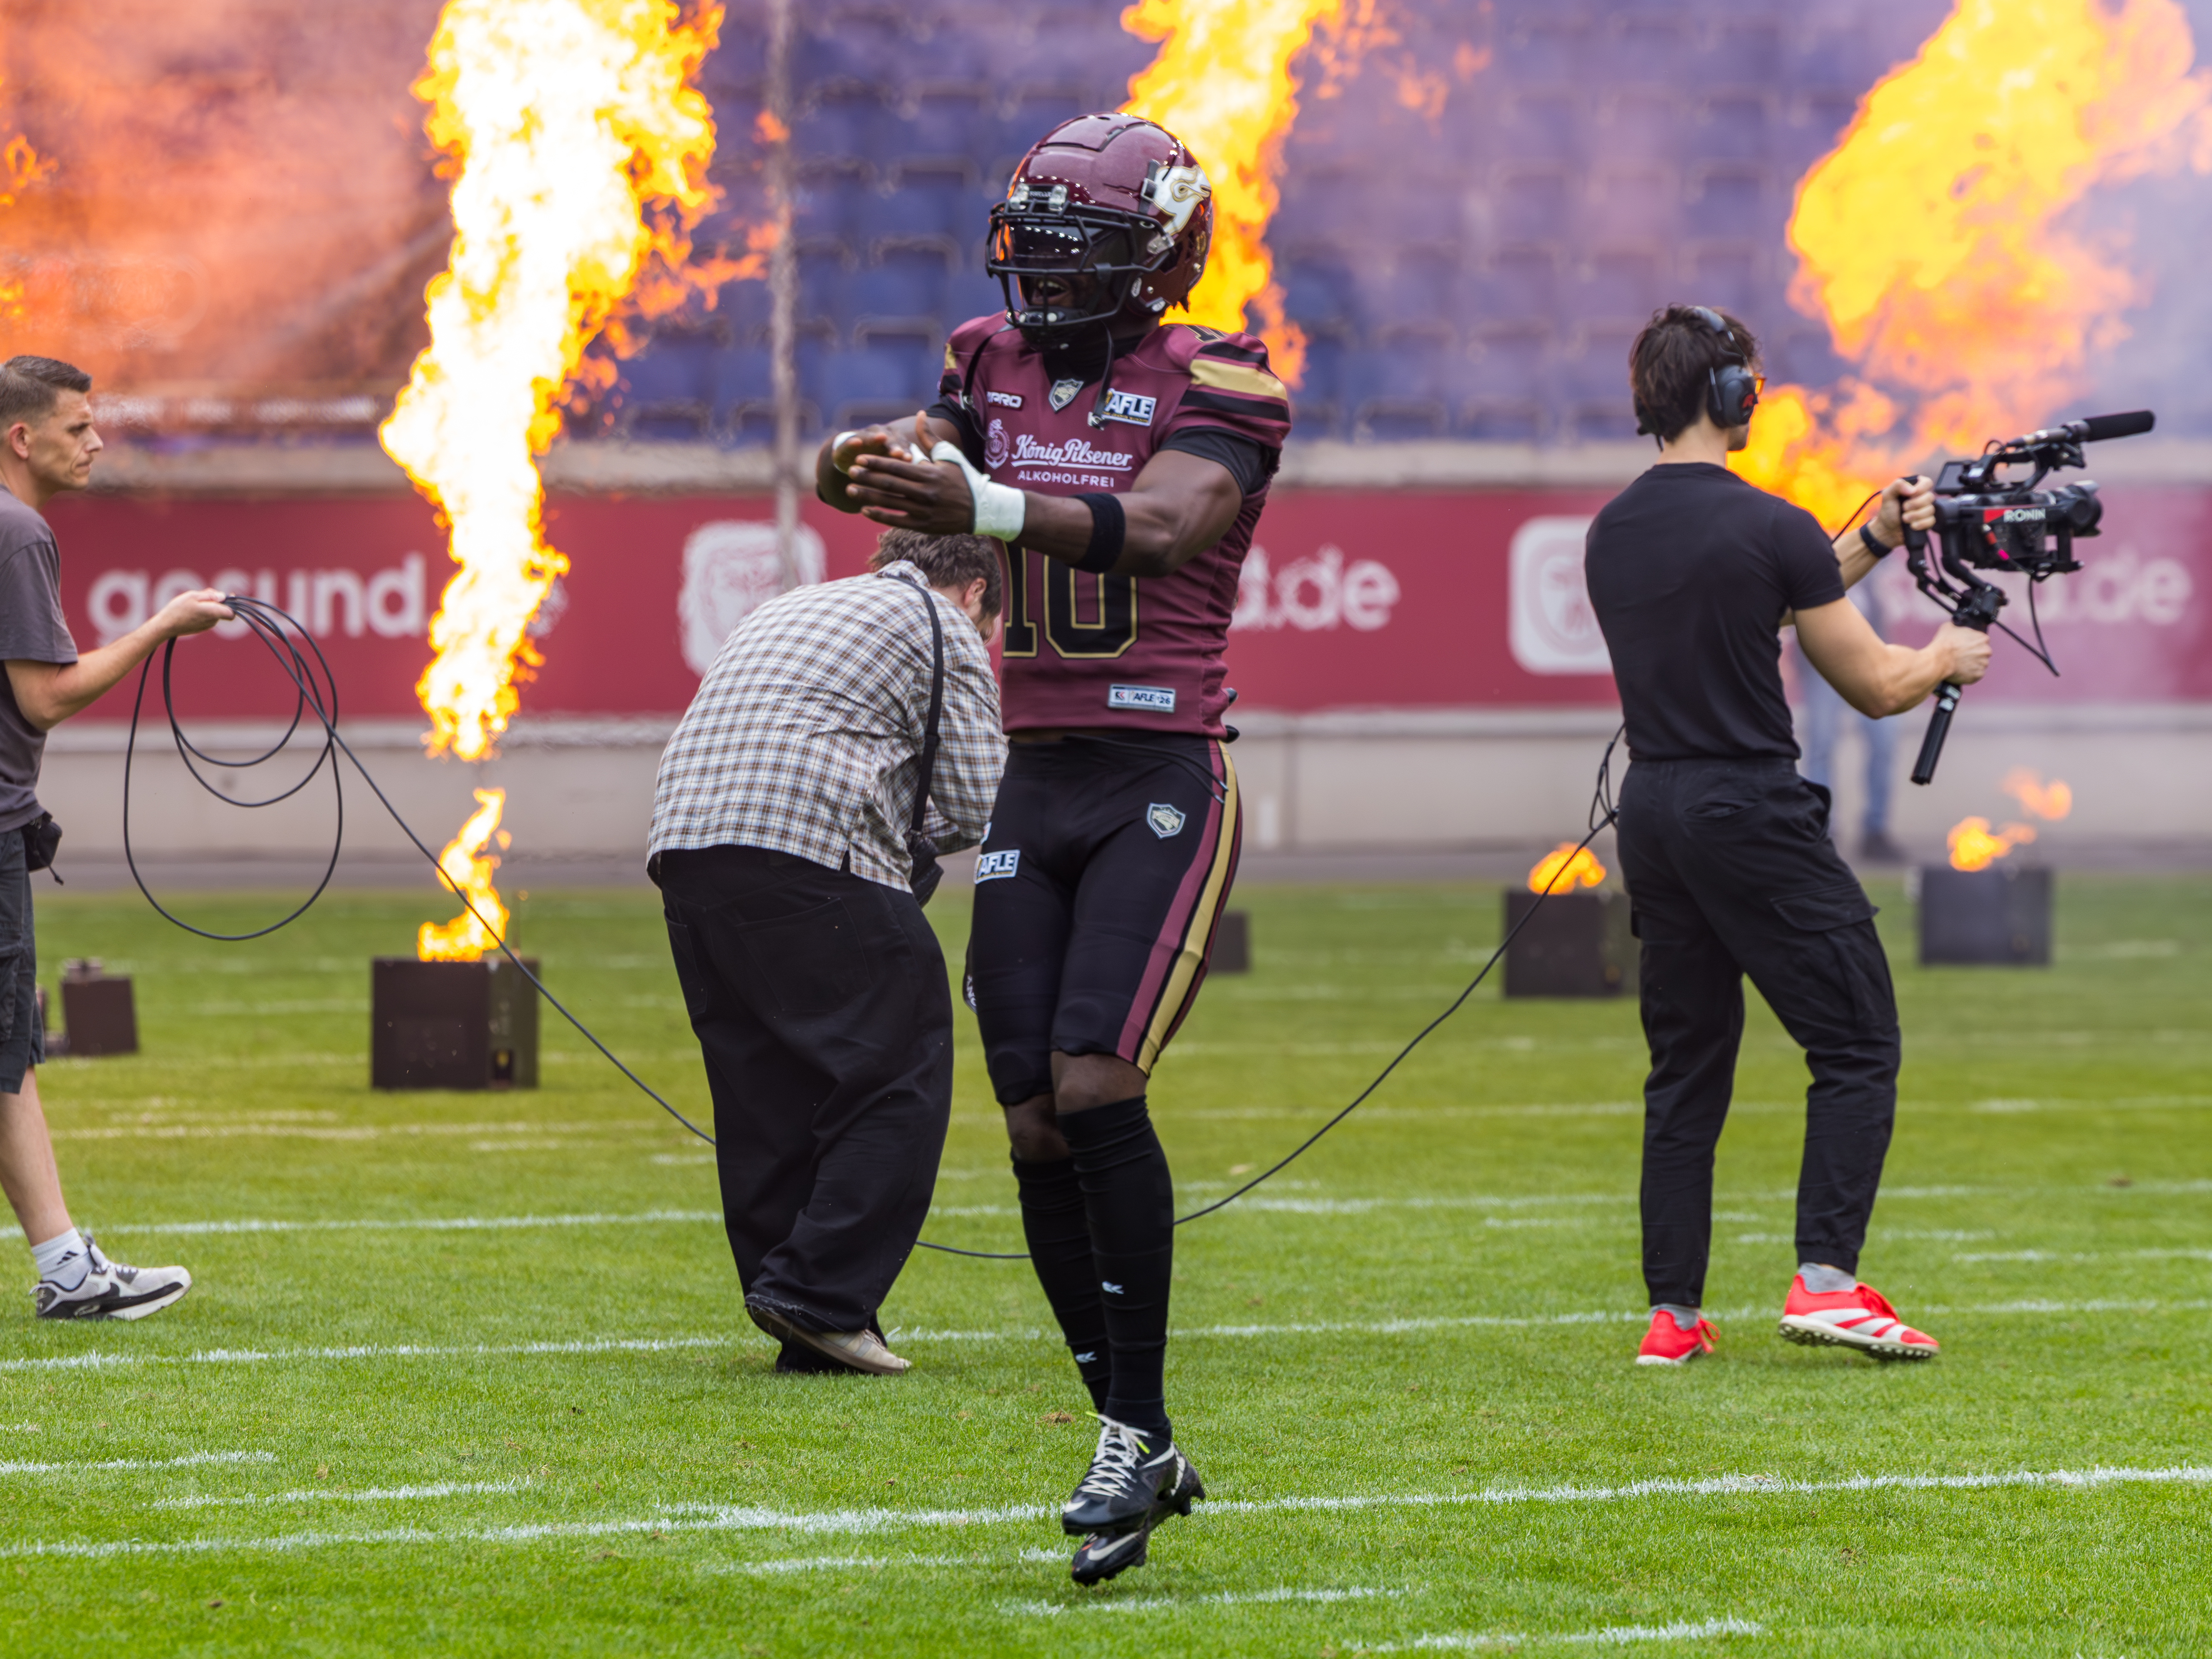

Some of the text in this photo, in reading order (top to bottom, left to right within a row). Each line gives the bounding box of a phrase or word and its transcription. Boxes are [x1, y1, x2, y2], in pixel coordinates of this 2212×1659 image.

[1104, 394, 1152, 418] AFLE
[1017, 470, 1114, 488] ALKOHOLFREI
[2003, 507, 2046, 523] RONIN
[1002, 543, 1139, 659] 10
[1133, 692, 1155, 702] AFLE
[978, 853, 1016, 877] AFLE
